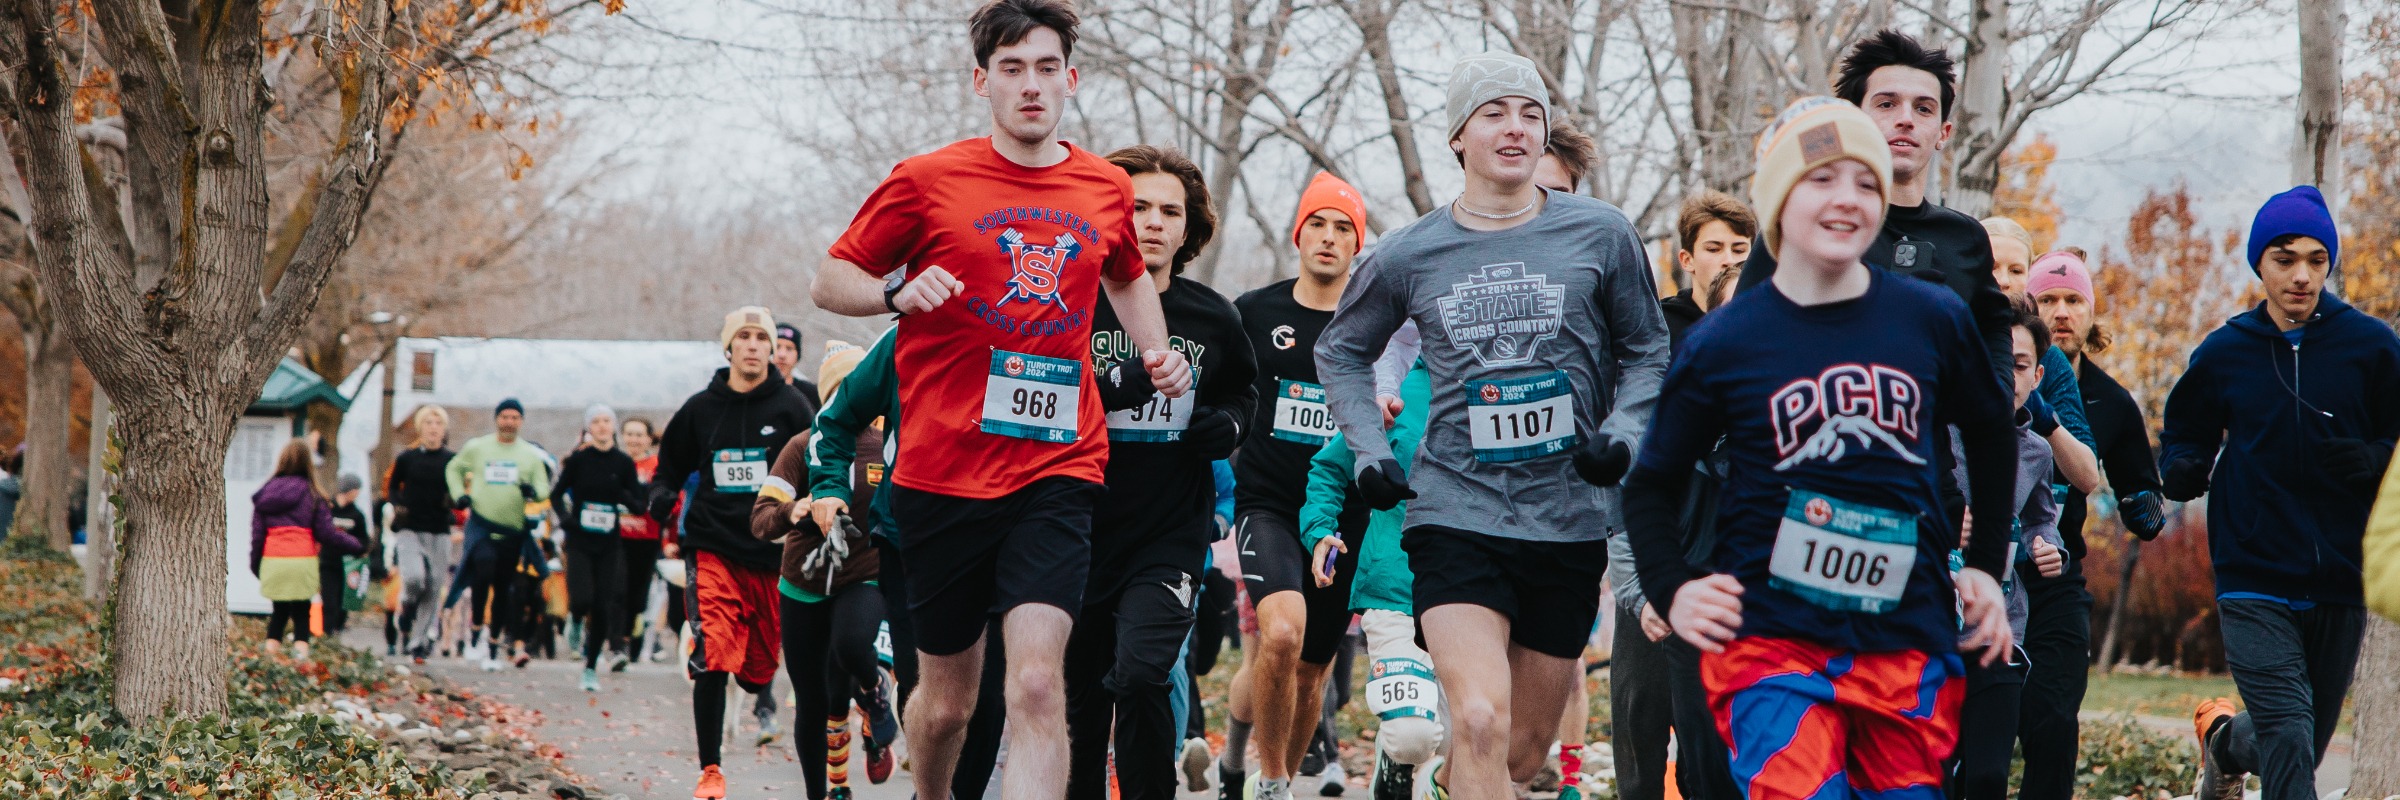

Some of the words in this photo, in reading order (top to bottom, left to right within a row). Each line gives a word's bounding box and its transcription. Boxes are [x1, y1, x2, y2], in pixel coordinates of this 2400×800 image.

[973, 206, 1102, 245] SOUTHWESTERN
[1487, 284, 1513, 295] 2024
[967, 296, 1016, 333] CROSS
[1020, 305, 1088, 337] COUNTRY
[1456, 292, 1548, 325] STATE
[1453, 323, 1496, 341] CROSS
[1498, 318, 1555, 335] COUNTRY
[1025, 368, 1046, 378] 2024
[1026, 360, 1056, 372] TURKEY
[1057, 365, 1078, 374] TROT
[1501, 383, 1535, 394] TURKEY
[1536, 378, 1557, 390] TROT
[1502, 392, 1526, 401] 2024
[1011, 387, 1058, 420] 968
[1769, 362, 1921, 457] PCR
[1289, 405, 1336, 431] 1005
[1489, 405, 1554, 441] 1107
[1048, 429, 1065, 441] 5K
[1167, 431, 1181, 442] 5K
[1546, 439, 1564, 453] 5K
[727, 466, 754, 482] 936
[1803, 540, 1890, 587] 1006
[1382, 681, 1419, 705] 565
